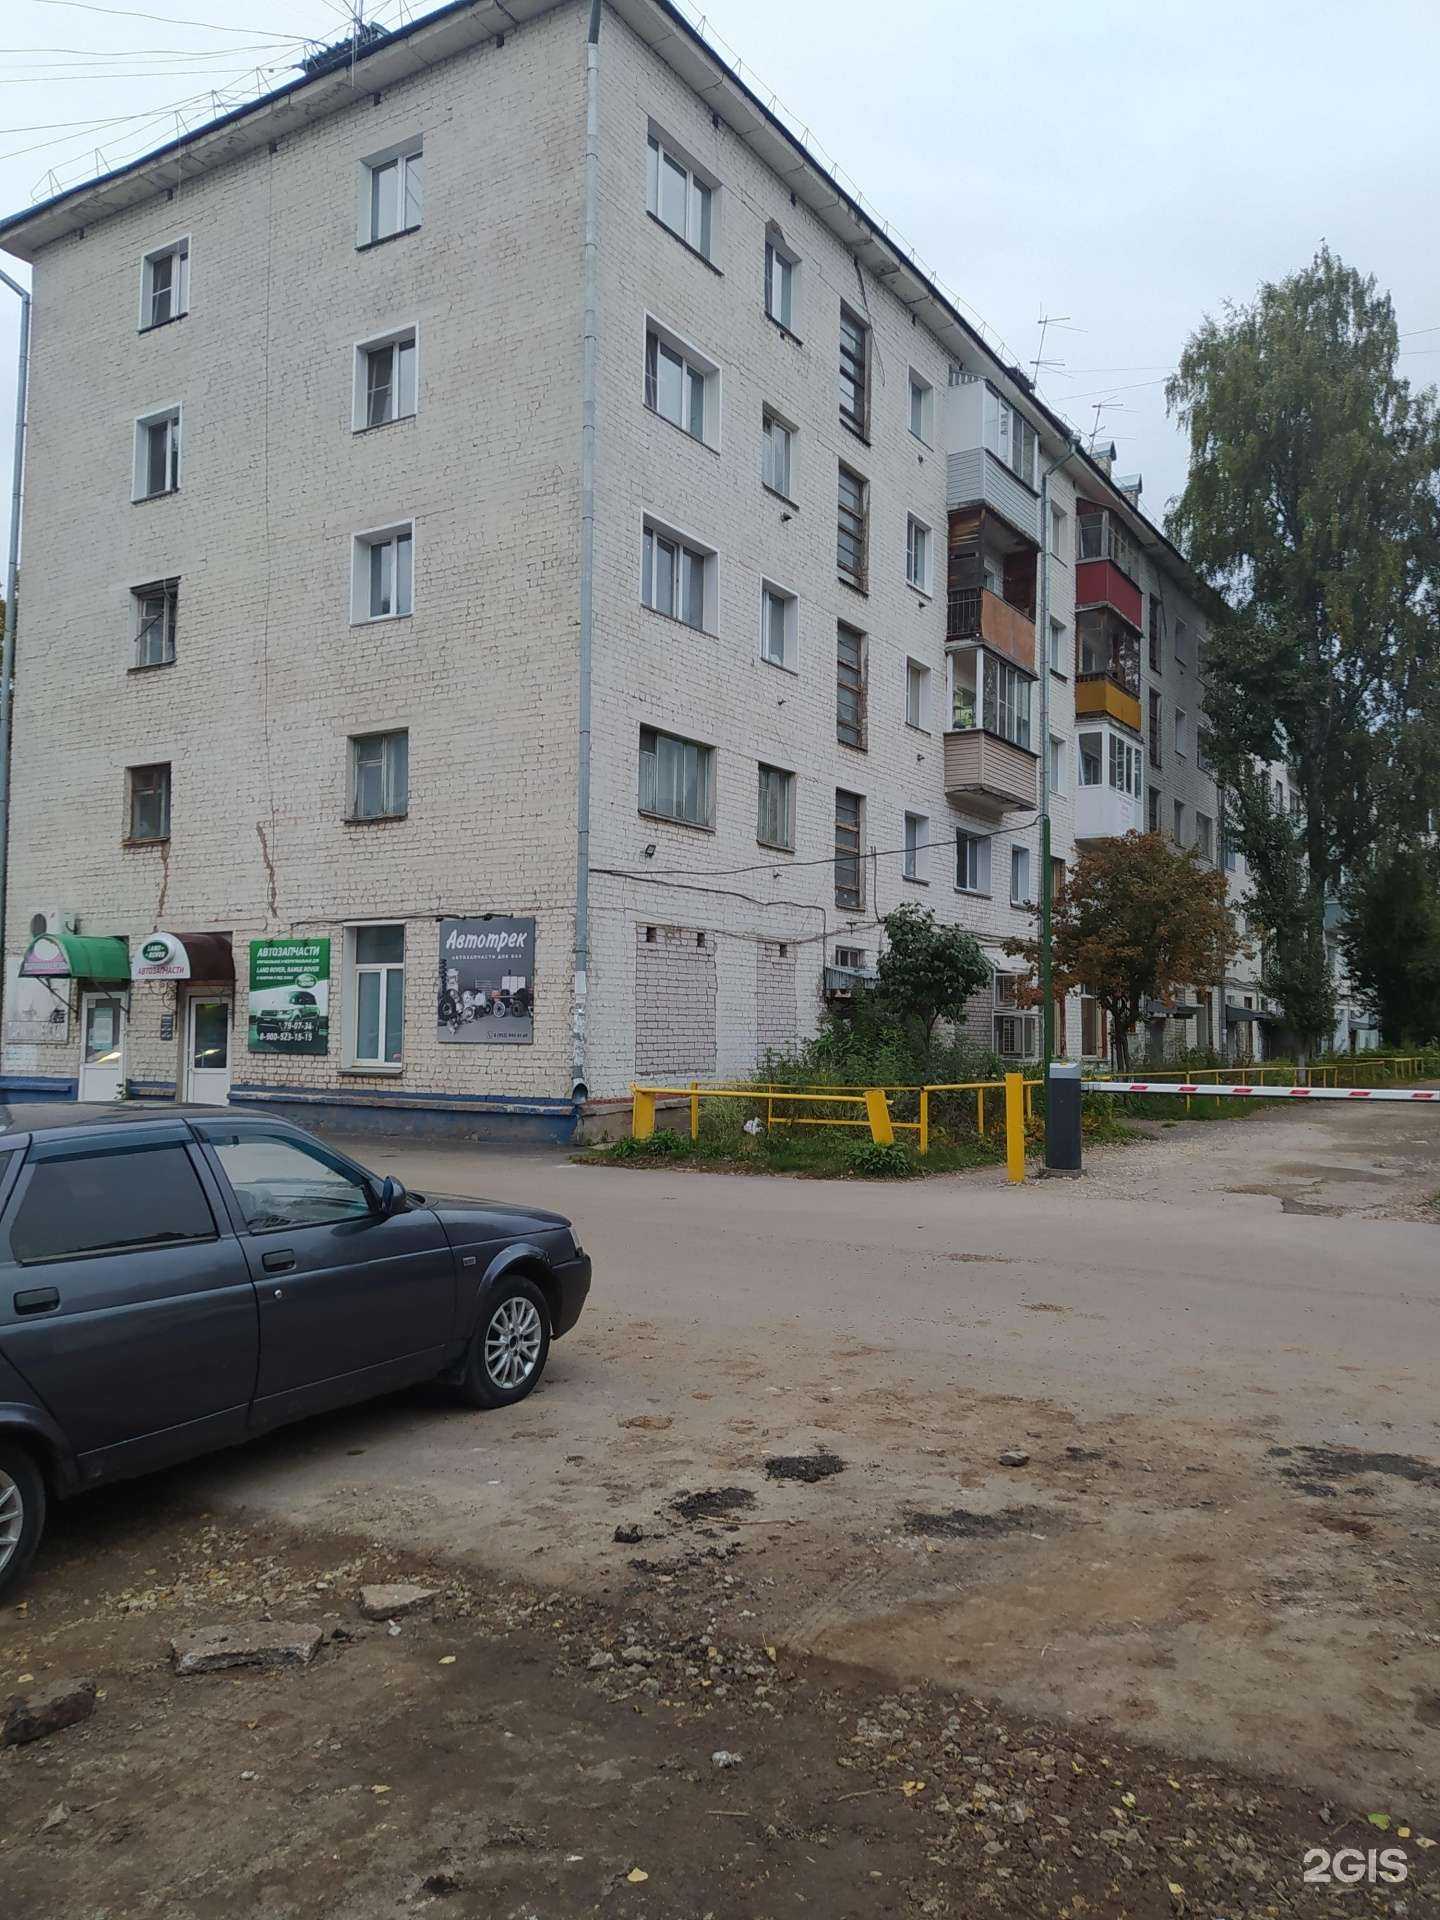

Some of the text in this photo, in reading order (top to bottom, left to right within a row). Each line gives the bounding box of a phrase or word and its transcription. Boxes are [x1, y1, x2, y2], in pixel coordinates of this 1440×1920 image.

[446, 929, 528, 952] Автотрек
[256, 945, 320, 957] АВТОЗАПЧАСТИ
[138, 966, 185, 975] АВТОЗАПЧАСТИ
